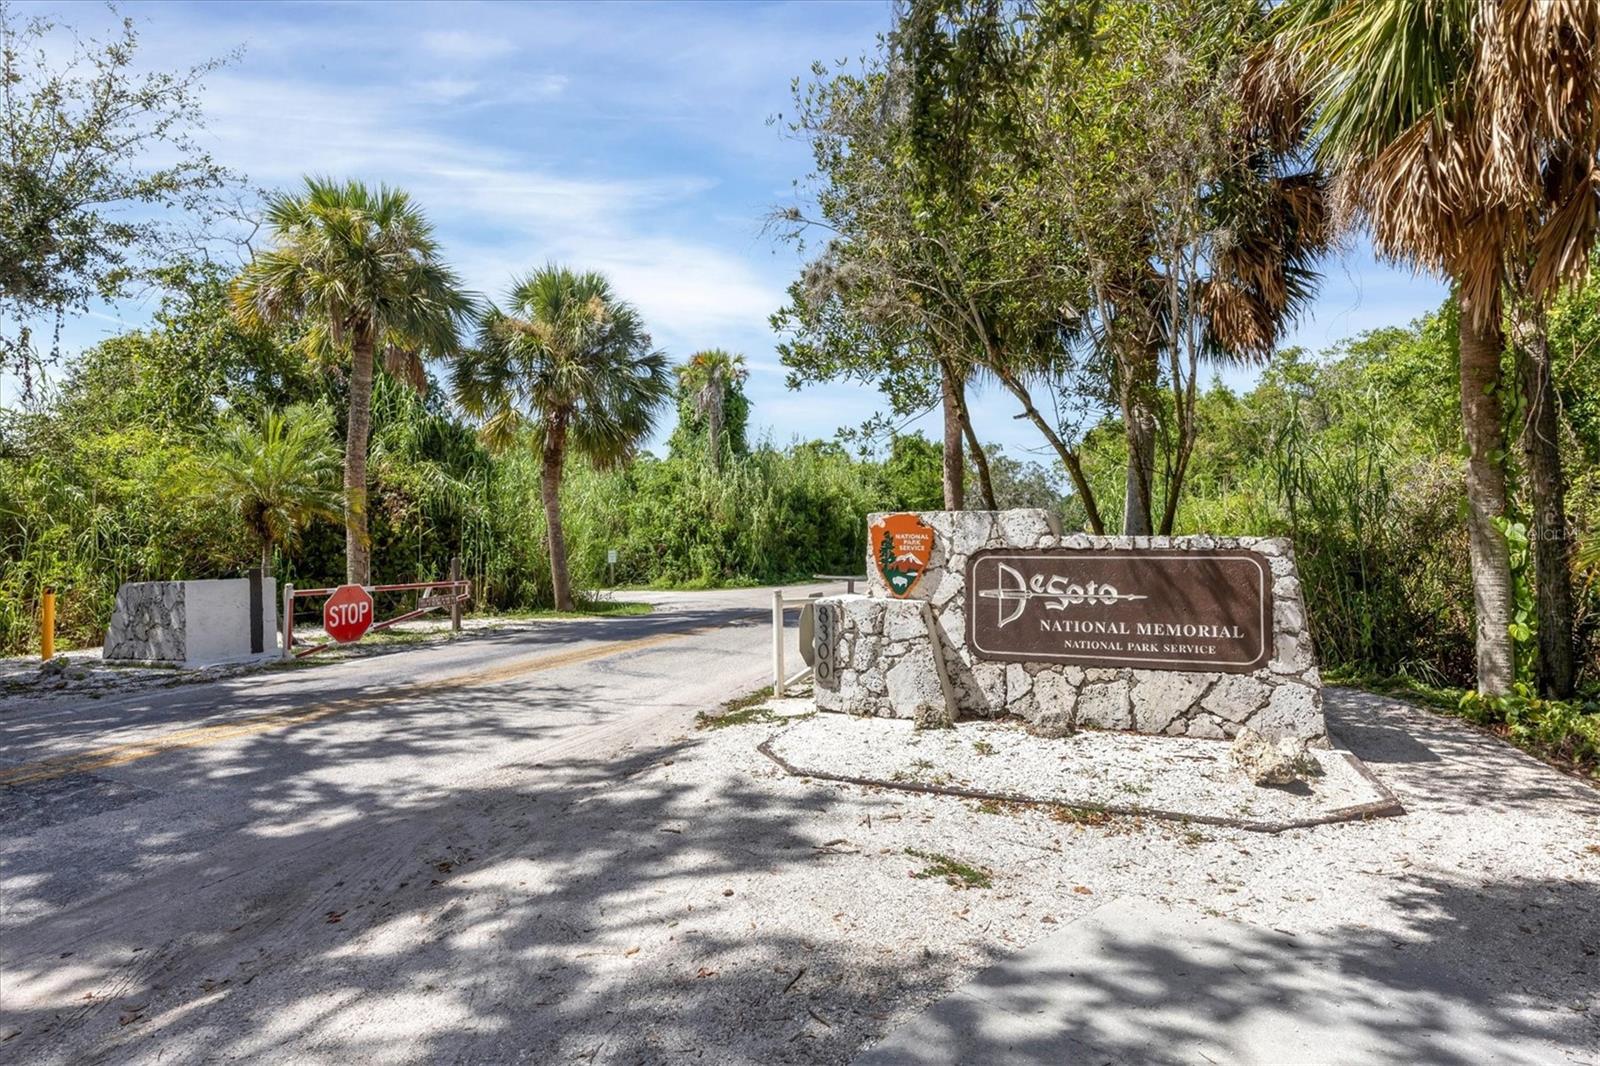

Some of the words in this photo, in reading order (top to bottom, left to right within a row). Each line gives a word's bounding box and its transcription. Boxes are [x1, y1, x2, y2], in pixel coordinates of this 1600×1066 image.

[329, 601, 369, 628] STOP
[1040, 619, 1130, 635] NATIONAL
[1136, 622, 1245, 639] MEMORIAL
[818, 606, 830, 679] 8300
[1064, 639, 1123, 651] NATIONAL
[1127, 642, 1159, 653] PARK
[1163, 643, 1216, 655] SERVICE
